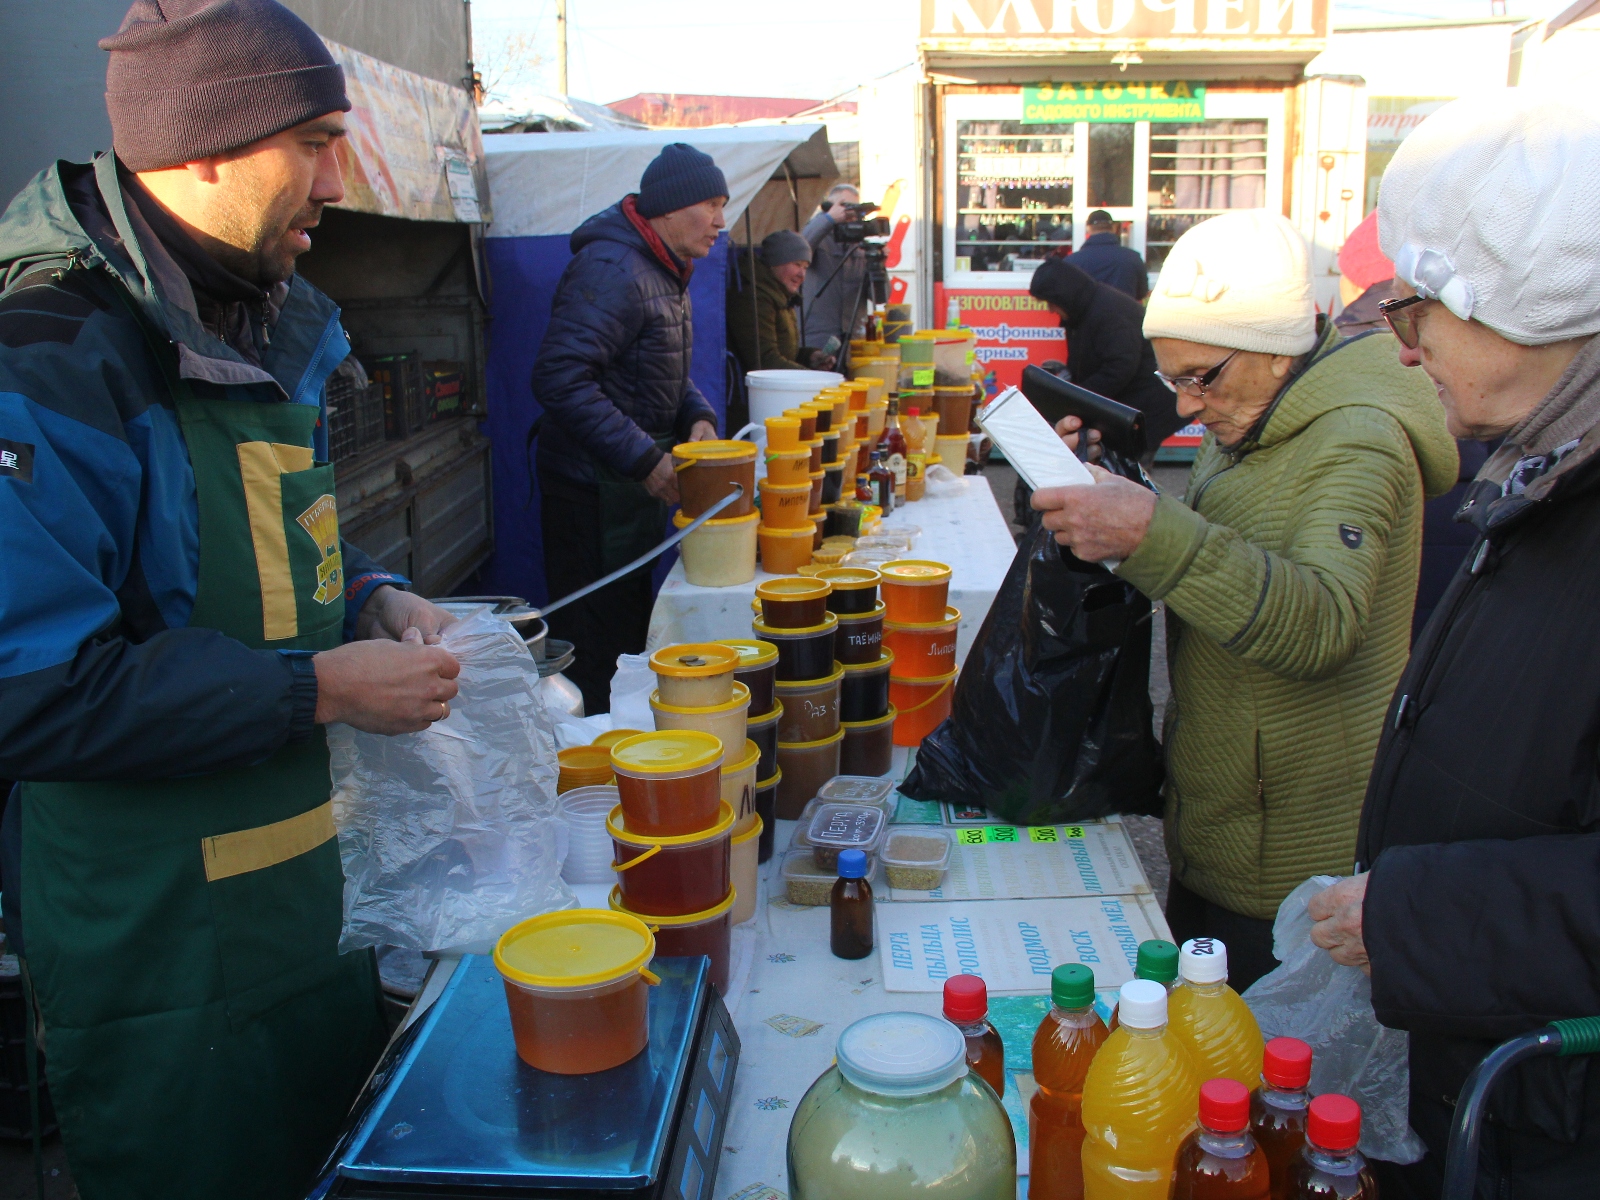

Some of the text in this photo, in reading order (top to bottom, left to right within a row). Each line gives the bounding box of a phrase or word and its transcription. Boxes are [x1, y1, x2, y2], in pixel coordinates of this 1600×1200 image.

[1036, 80, 1191, 100] ЗАТОЧКА
[1026, 103, 1202, 120] САДОВОГО ИНСТРУМЕНТА
[344, 573, 394, 600] OSRAM
[967, 829, 982, 844] 600
[994, 827, 1014, 842] 500
[1037, 828, 1057, 842] 500
[1064, 839, 1104, 894] ЛИПОВЫЙ
[1100, 900, 1127, 923] МЁД
[889, 931, 914, 971] ПЕРГА
[919, 923, 949, 980] ПЫЛЬЦА
[949, 916, 982, 977] РОПОЛИС
[1018, 921, 1052, 977] ПОДМОР
[1069, 929, 1101, 964] ВОСК
